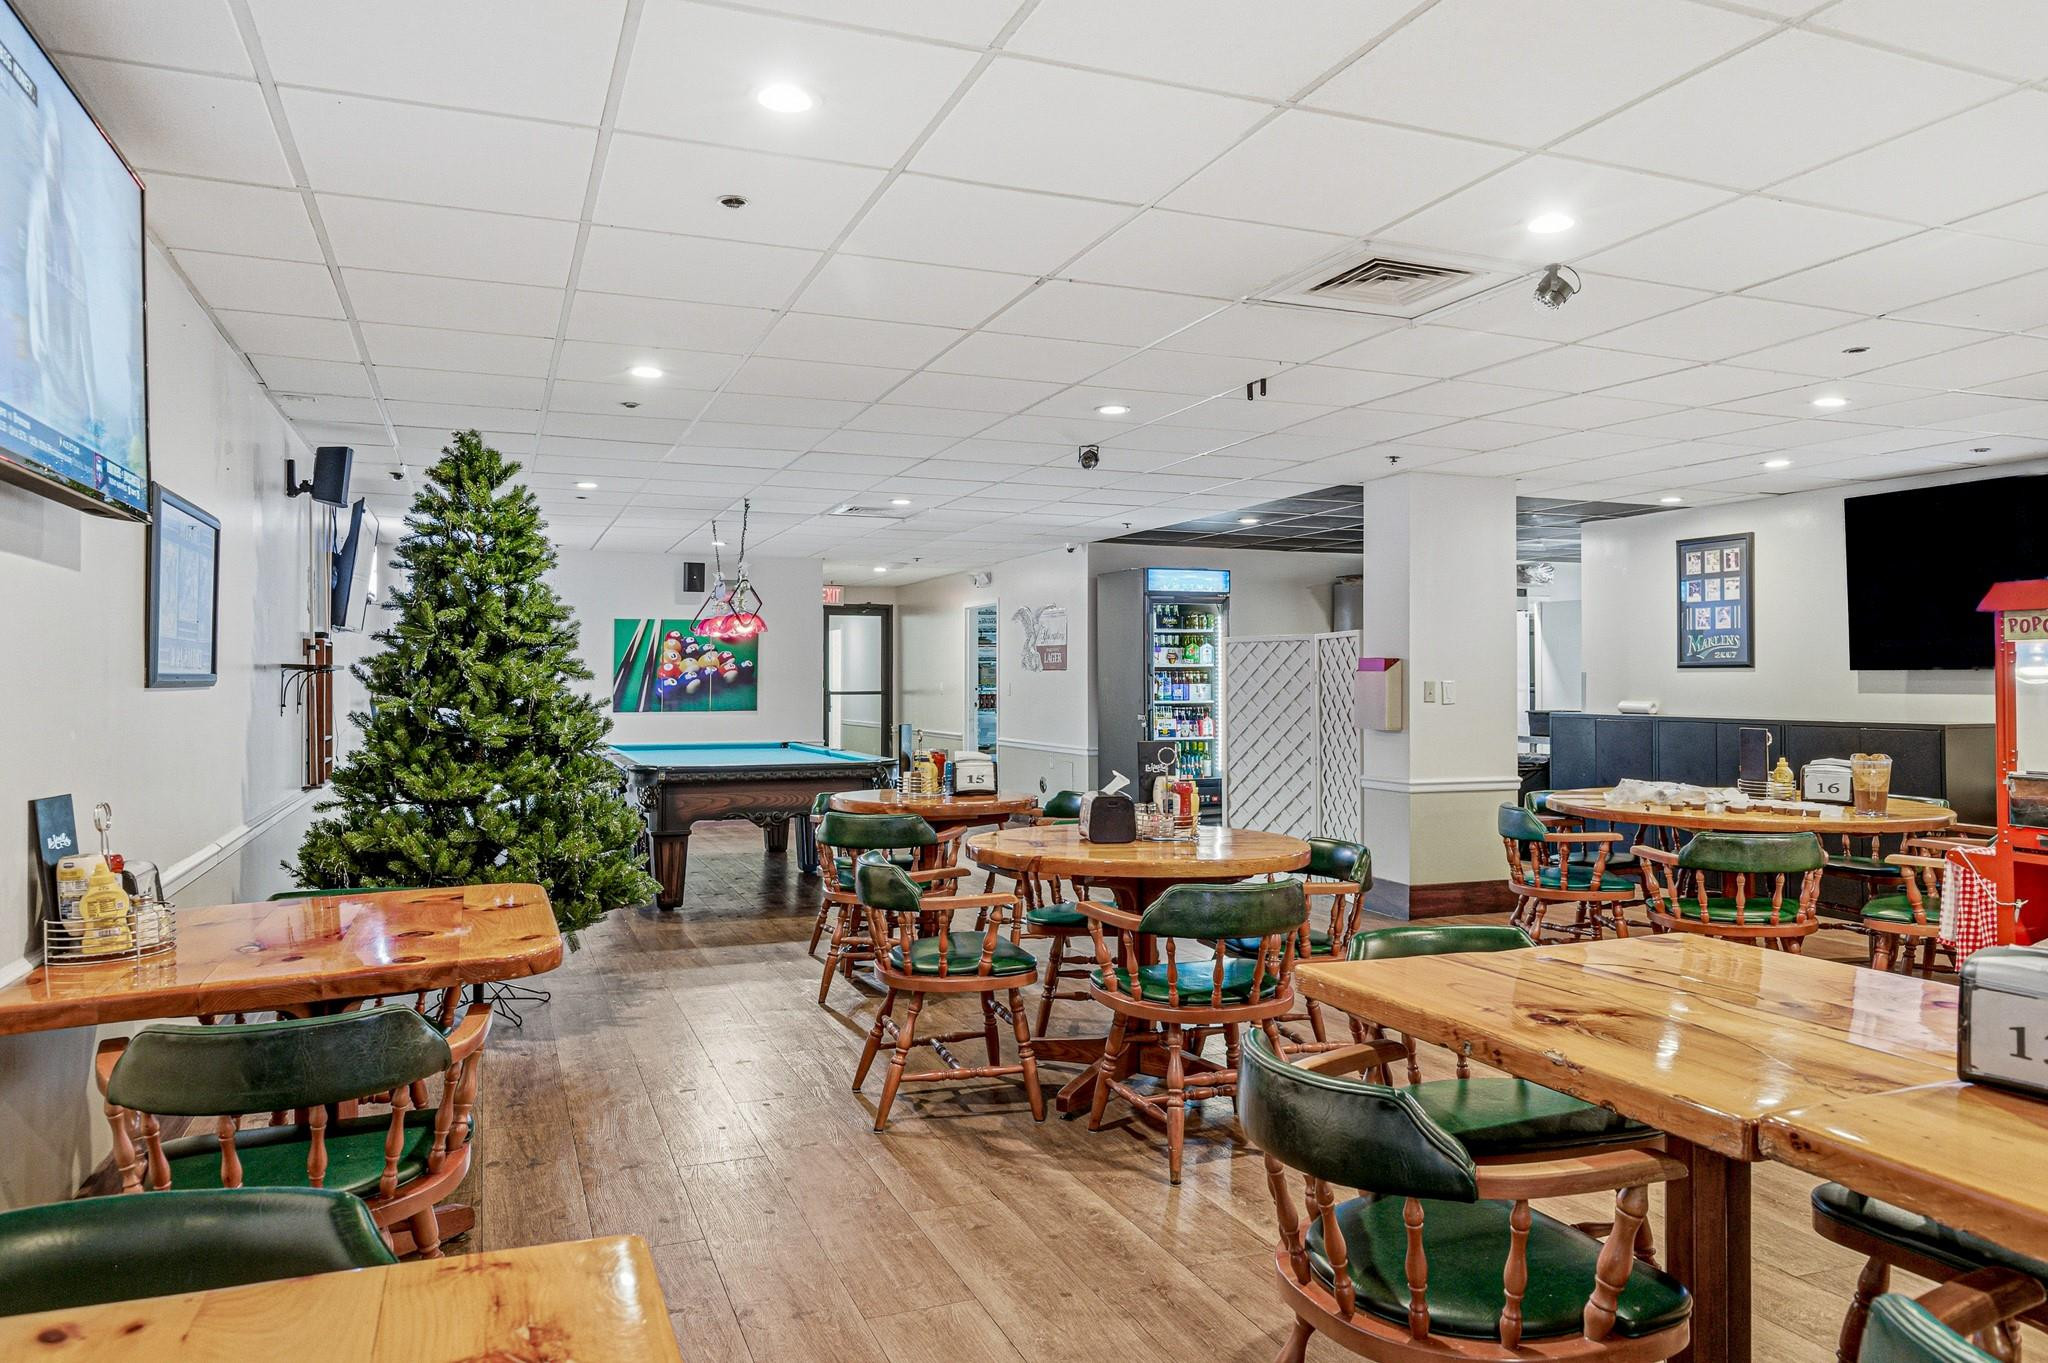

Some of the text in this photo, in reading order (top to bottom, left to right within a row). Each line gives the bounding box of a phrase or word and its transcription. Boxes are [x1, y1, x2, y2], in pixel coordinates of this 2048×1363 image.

[966, 774, 985, 784] 15
[1816, 782, 1840, 794] 16
[2009, 1026, 2048, 1065] 1
